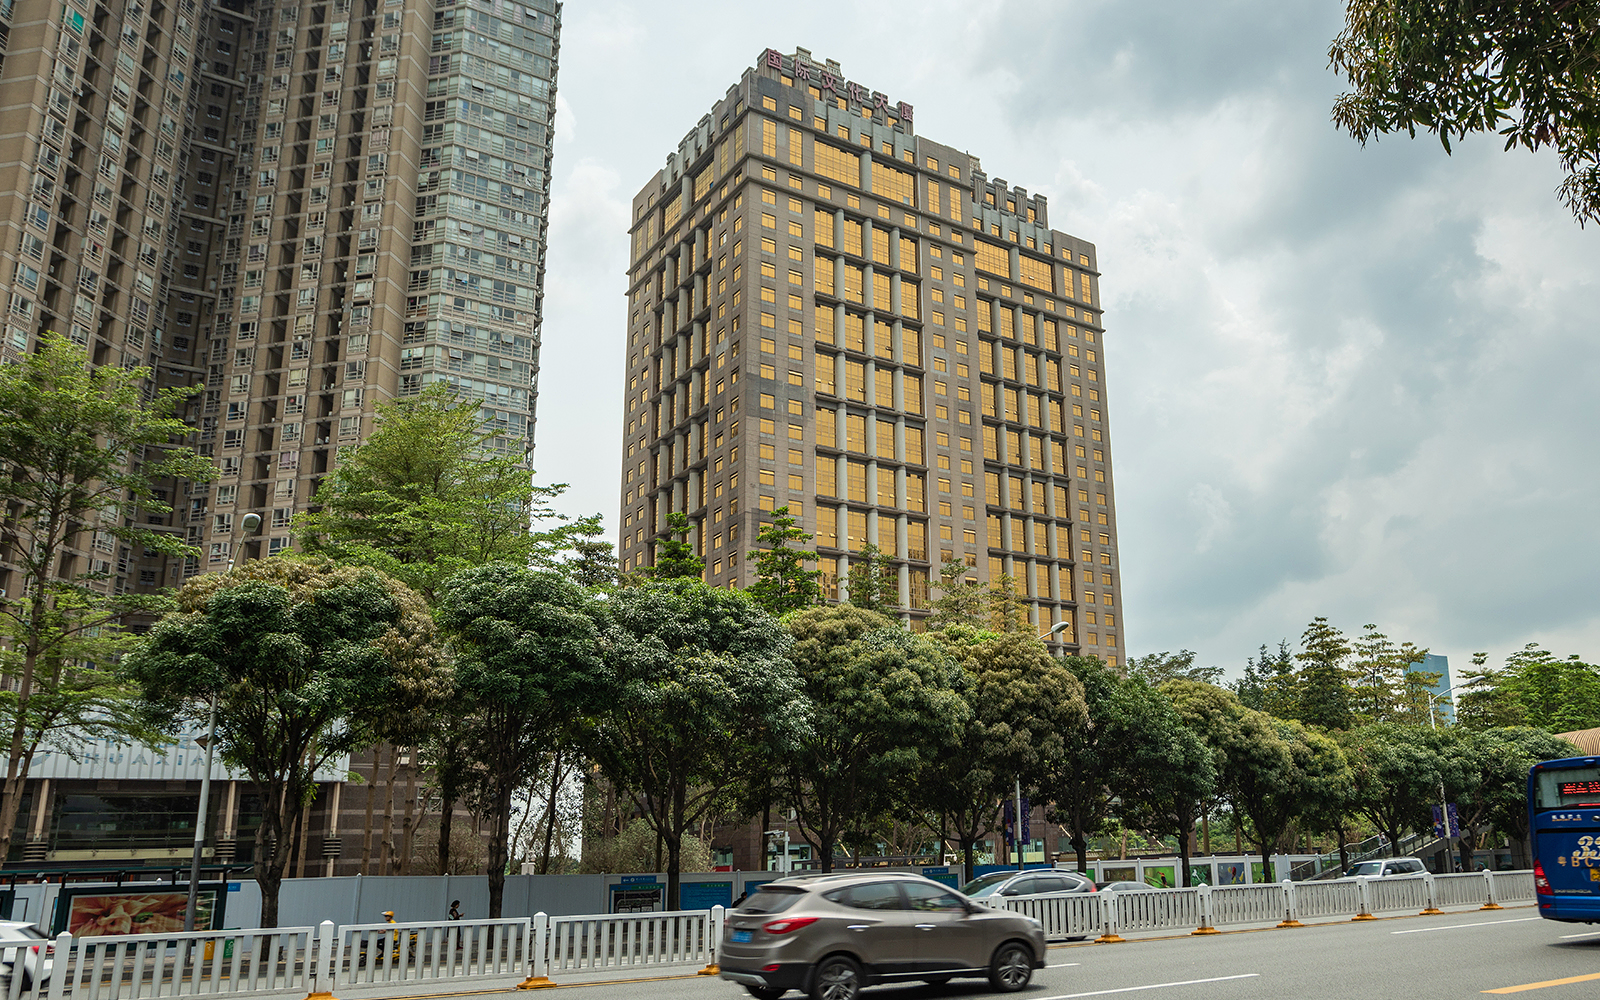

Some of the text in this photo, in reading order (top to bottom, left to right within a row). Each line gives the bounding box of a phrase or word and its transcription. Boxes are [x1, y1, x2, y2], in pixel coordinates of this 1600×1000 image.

[767, 49, 914, 122] 国际文化大厦
